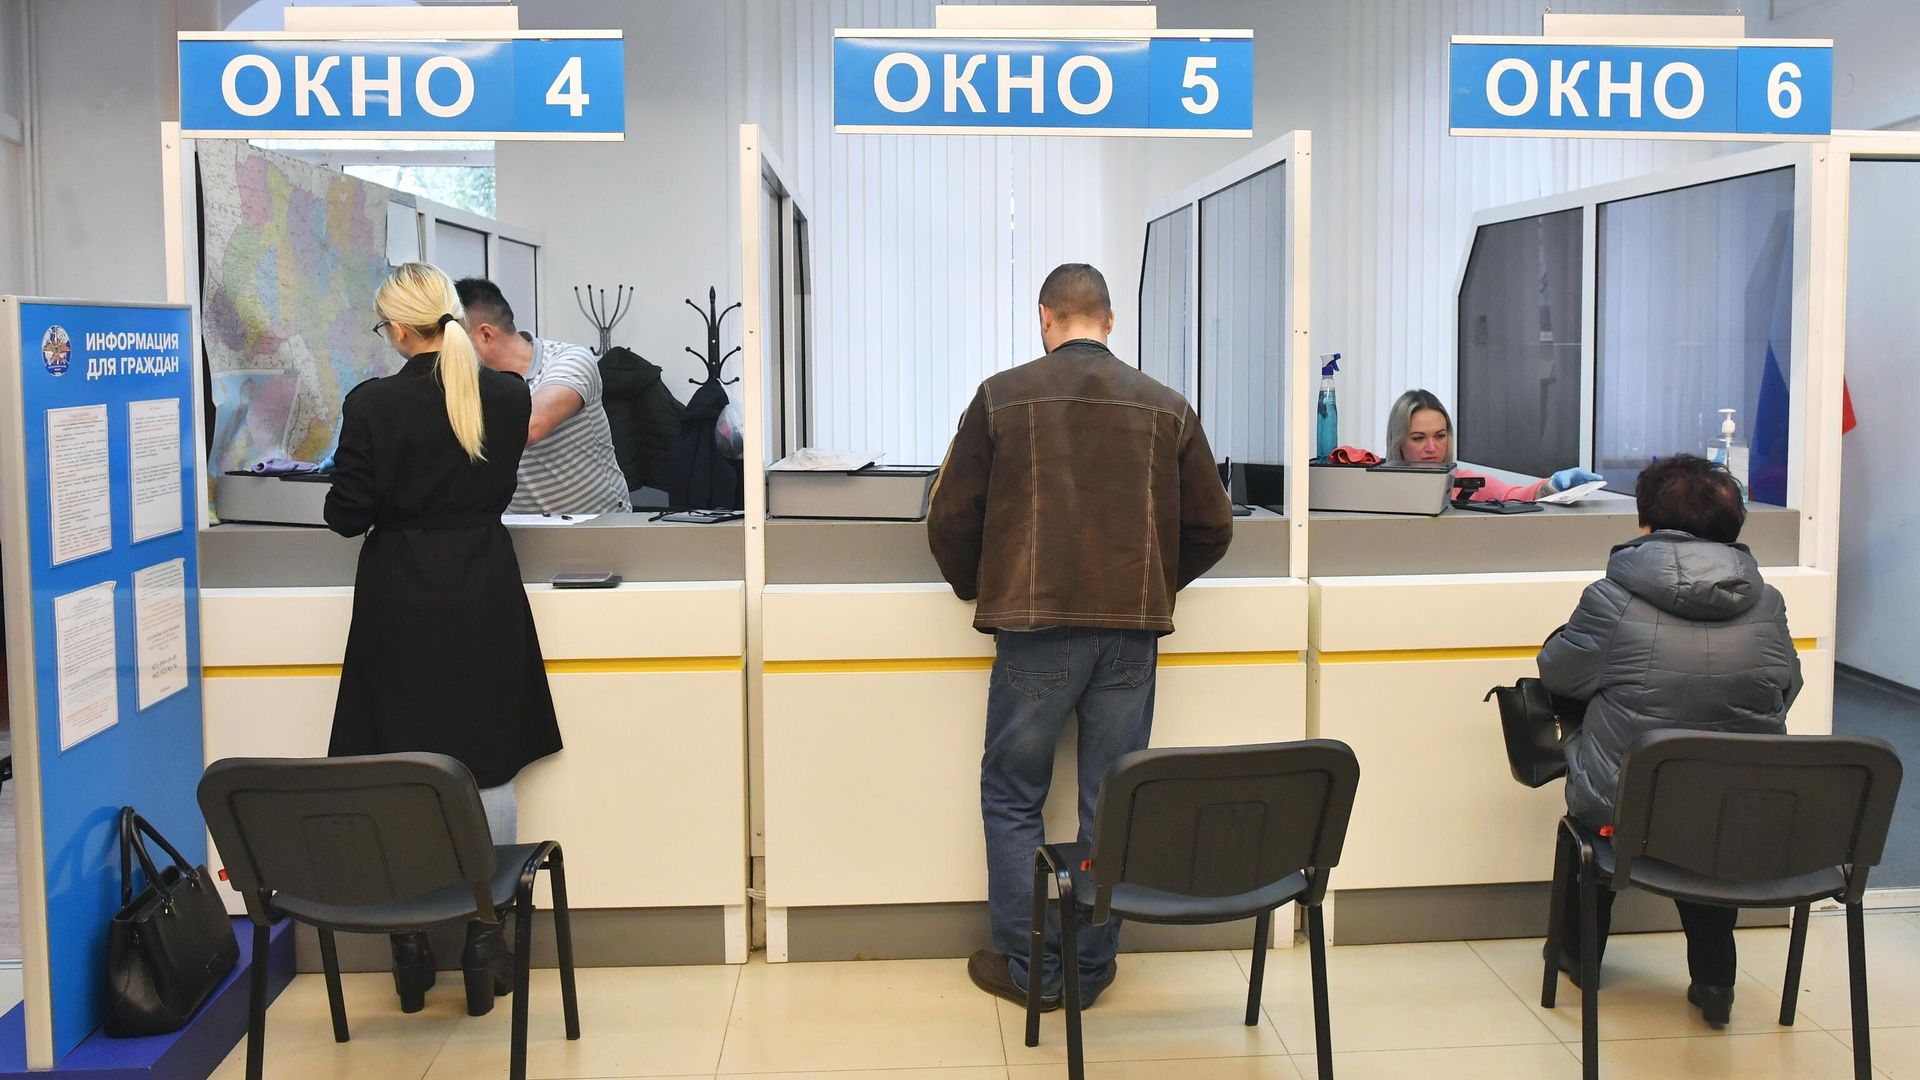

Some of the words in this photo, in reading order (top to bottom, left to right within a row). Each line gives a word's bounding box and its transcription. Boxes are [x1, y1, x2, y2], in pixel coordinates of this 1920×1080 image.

[222, 54, 475, 117] ОКНО
[546, 57, 589, 117] 4
[874, 52, 1113, 115] ОКНО
[1181, 57, 1219, 115] 5
[1486, 58, 1705, 119] ОКНО
[1767, 62, 1802, 118] 6
[86, 332, 179, 352] ИНФОРМАЦИЯ
[86, 357, 117, 381] ДЛЯ
[121, 356, 179, 376] ГРАЖДАН
